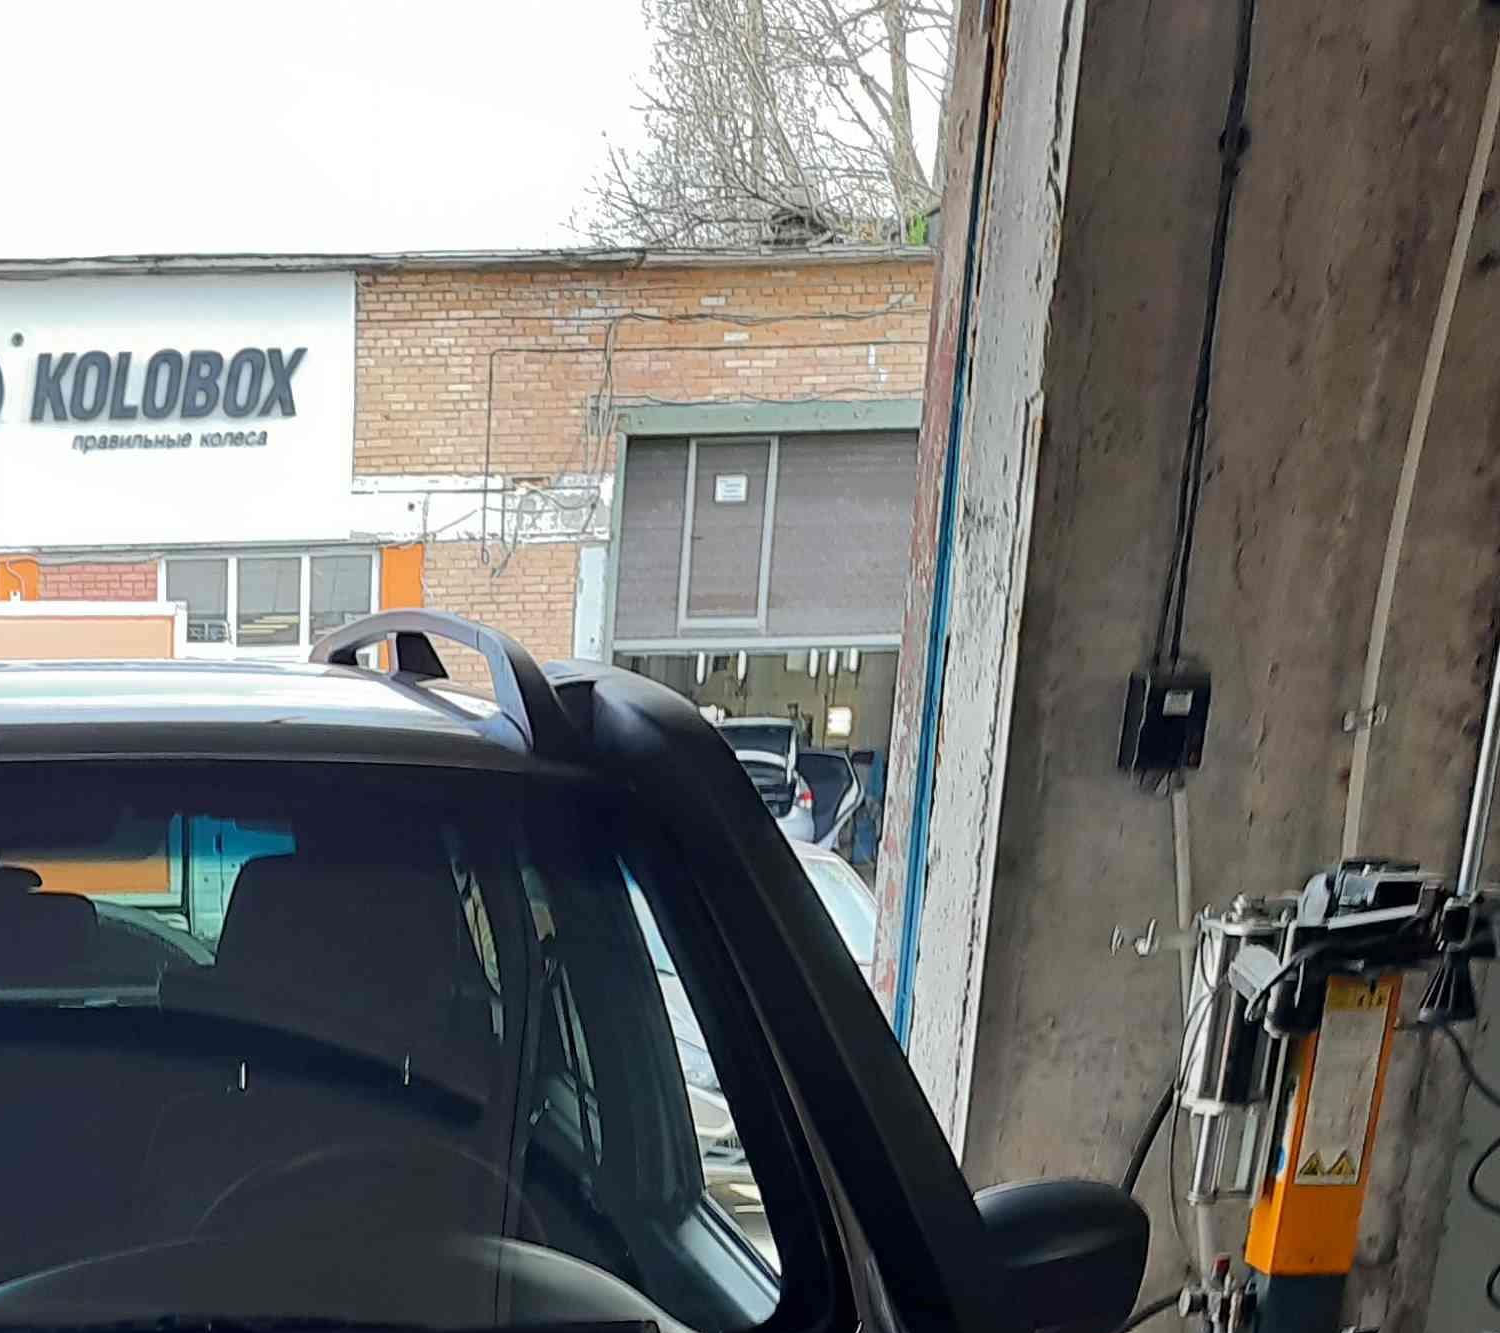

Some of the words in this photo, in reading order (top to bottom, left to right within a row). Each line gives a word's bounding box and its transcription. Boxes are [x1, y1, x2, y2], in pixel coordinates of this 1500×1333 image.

[30, 346, 308, 423] KOLOBOX
[71, 432, 192, 454] правильные
[199, 430, 268, 448] колеса
